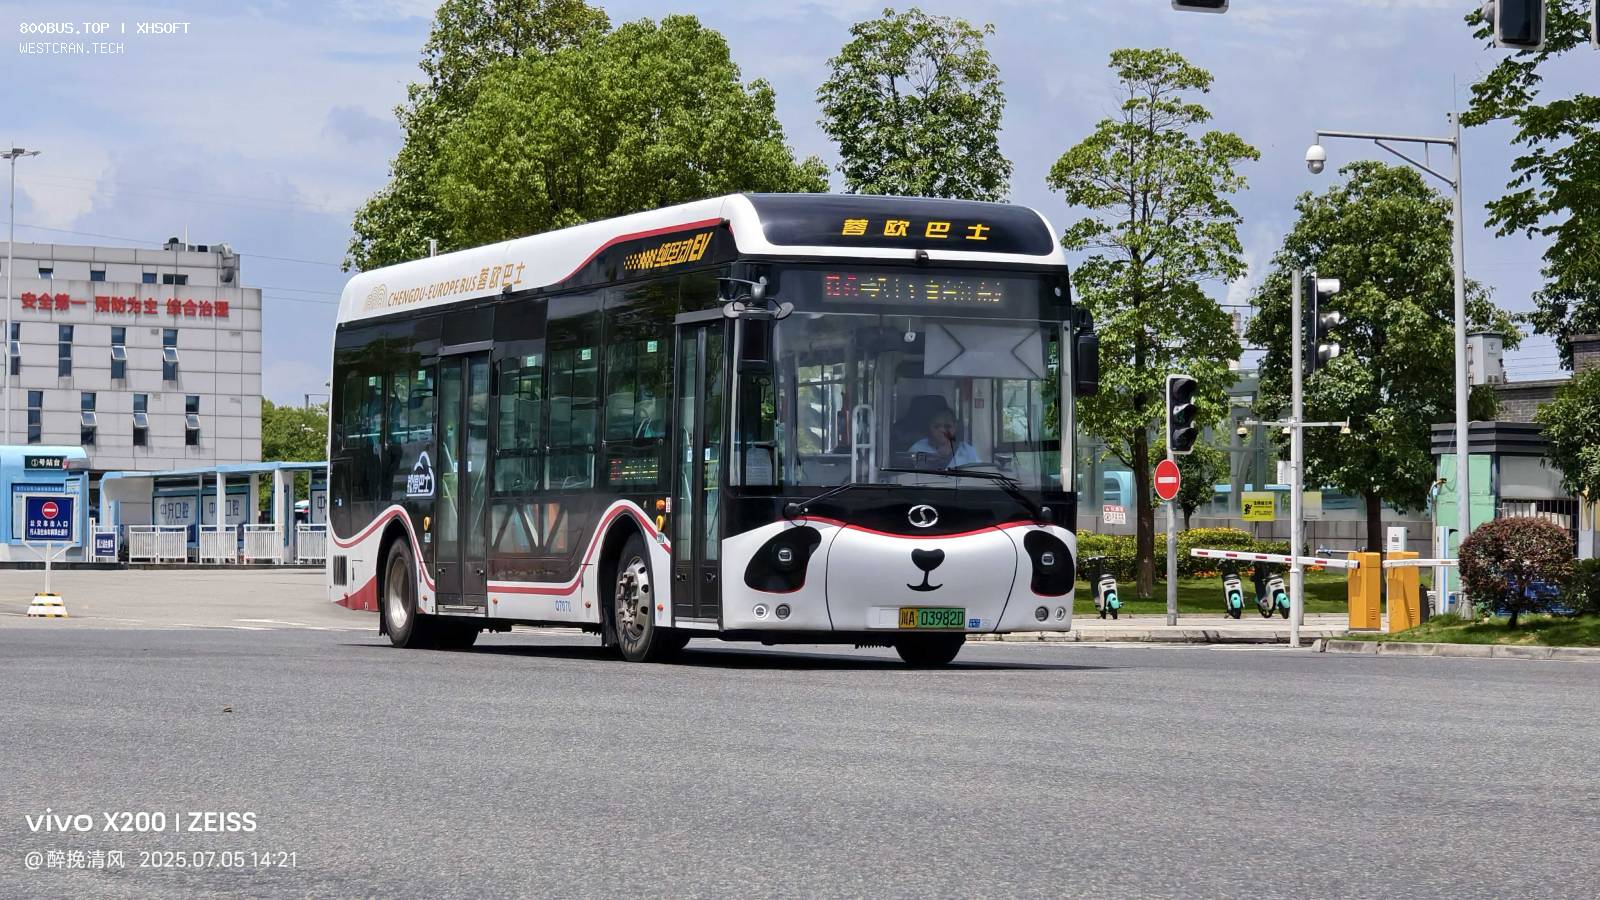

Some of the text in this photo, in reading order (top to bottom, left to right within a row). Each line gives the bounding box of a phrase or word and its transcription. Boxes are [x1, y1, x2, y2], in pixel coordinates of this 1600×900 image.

[841, 218, 990, 241] 蓉欧巴士
[21, 291, 230, 319] 安全第一 预防为主 综合治理
